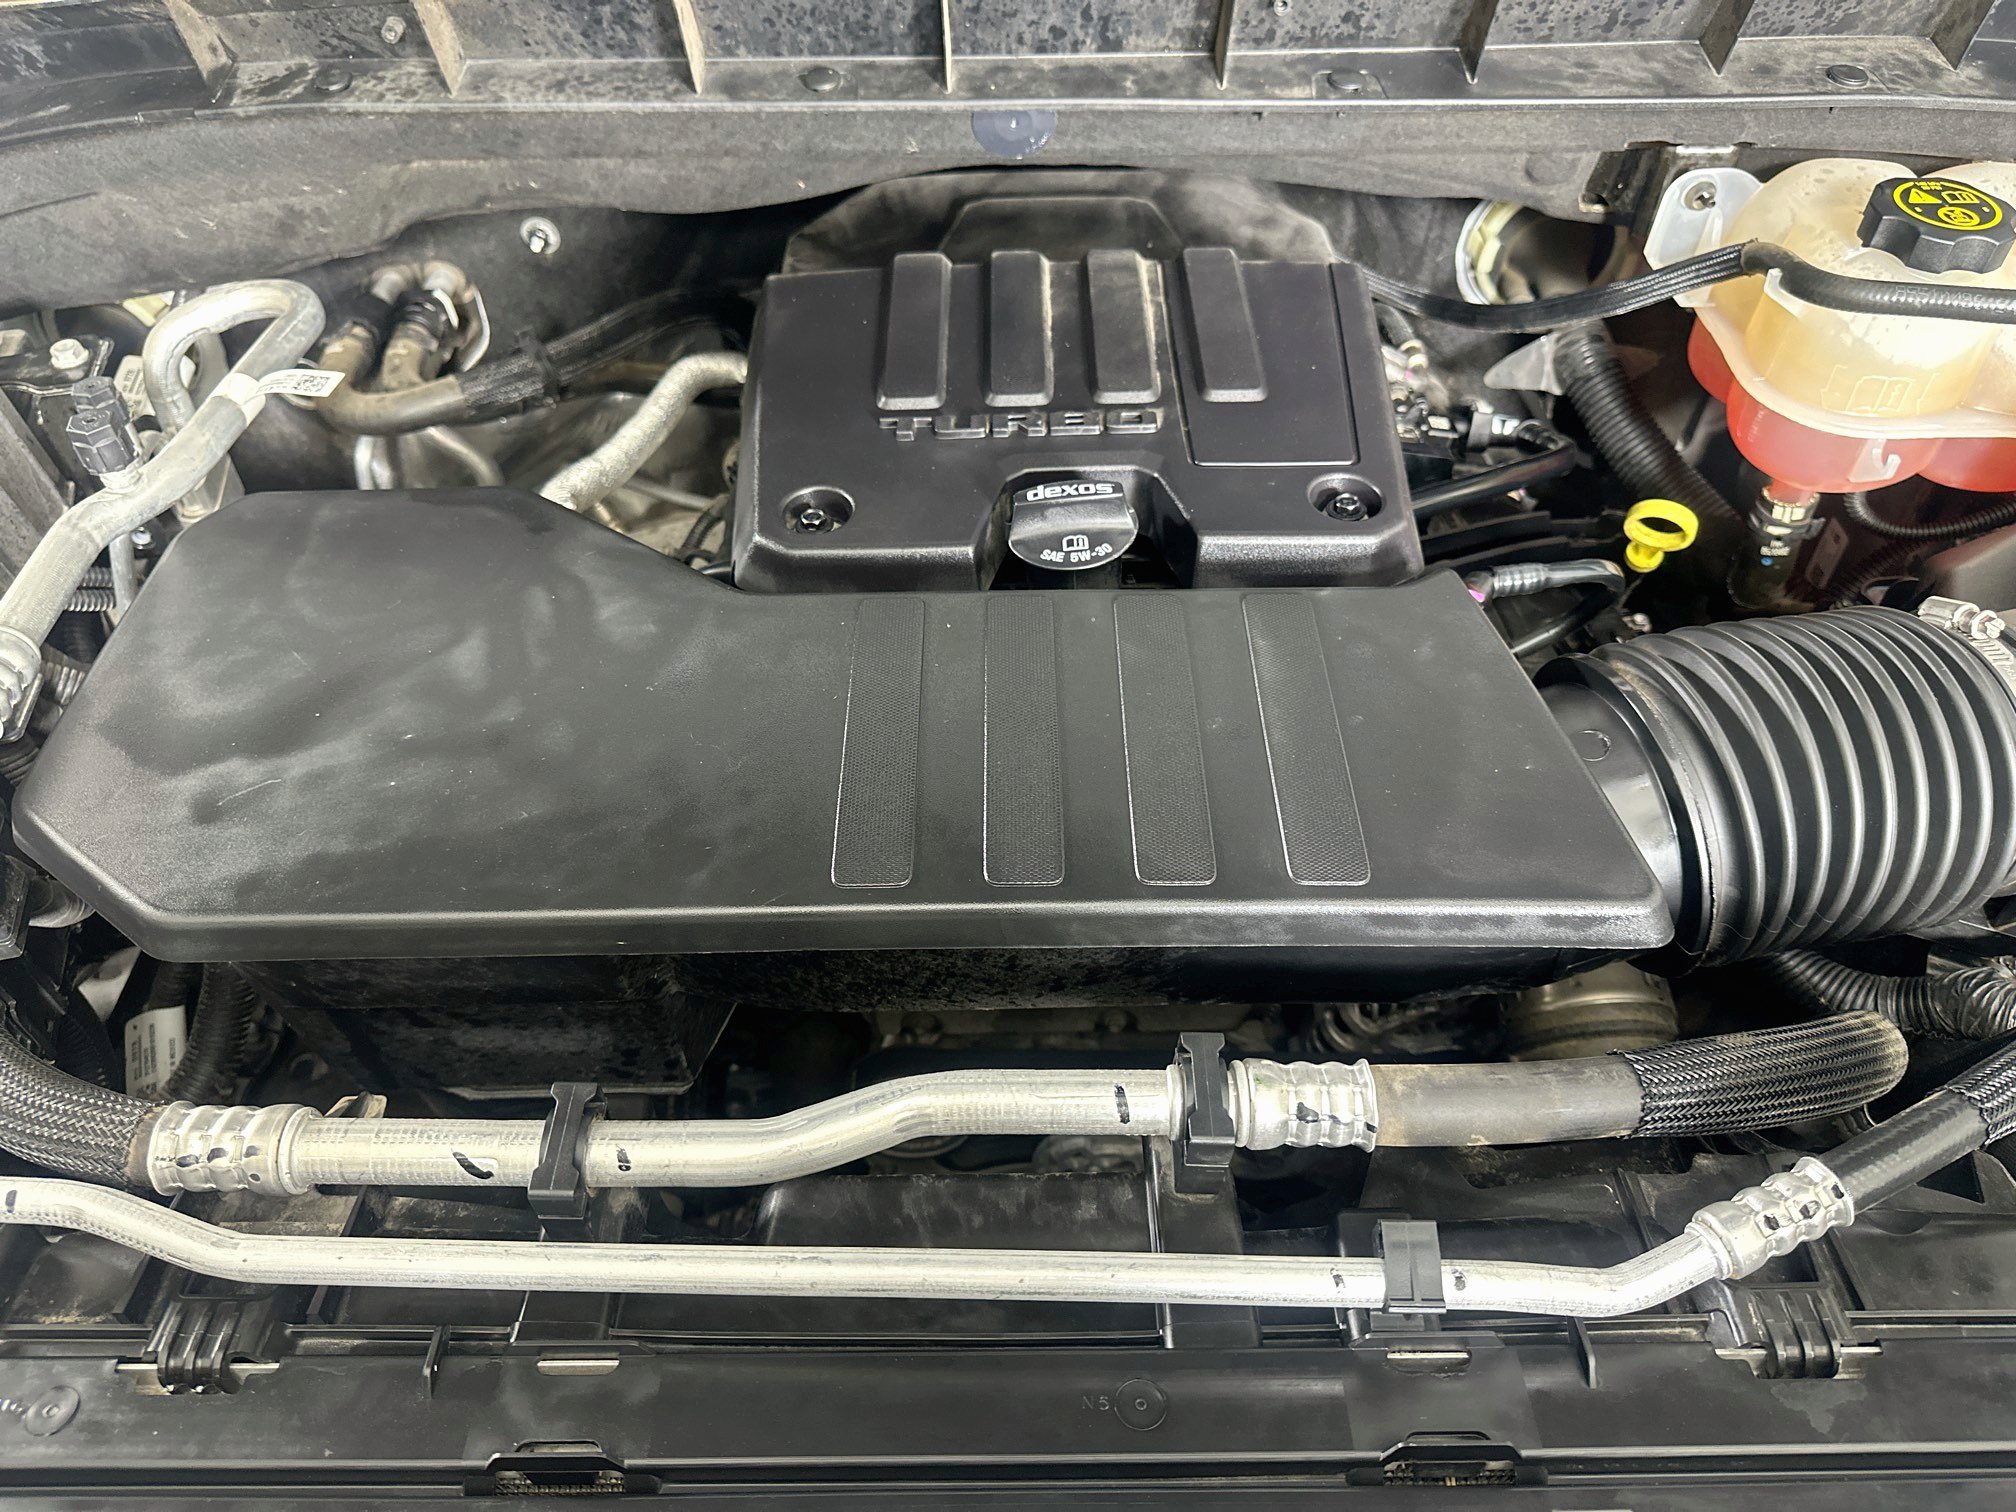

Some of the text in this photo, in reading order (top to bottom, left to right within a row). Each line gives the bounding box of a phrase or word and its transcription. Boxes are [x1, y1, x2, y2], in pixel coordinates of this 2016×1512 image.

[878, 408, 1162, 442] TURBO
[1026, 483, 1113, 502] dexos
[1040, 543, 1113, 562] SAE 5W-30
